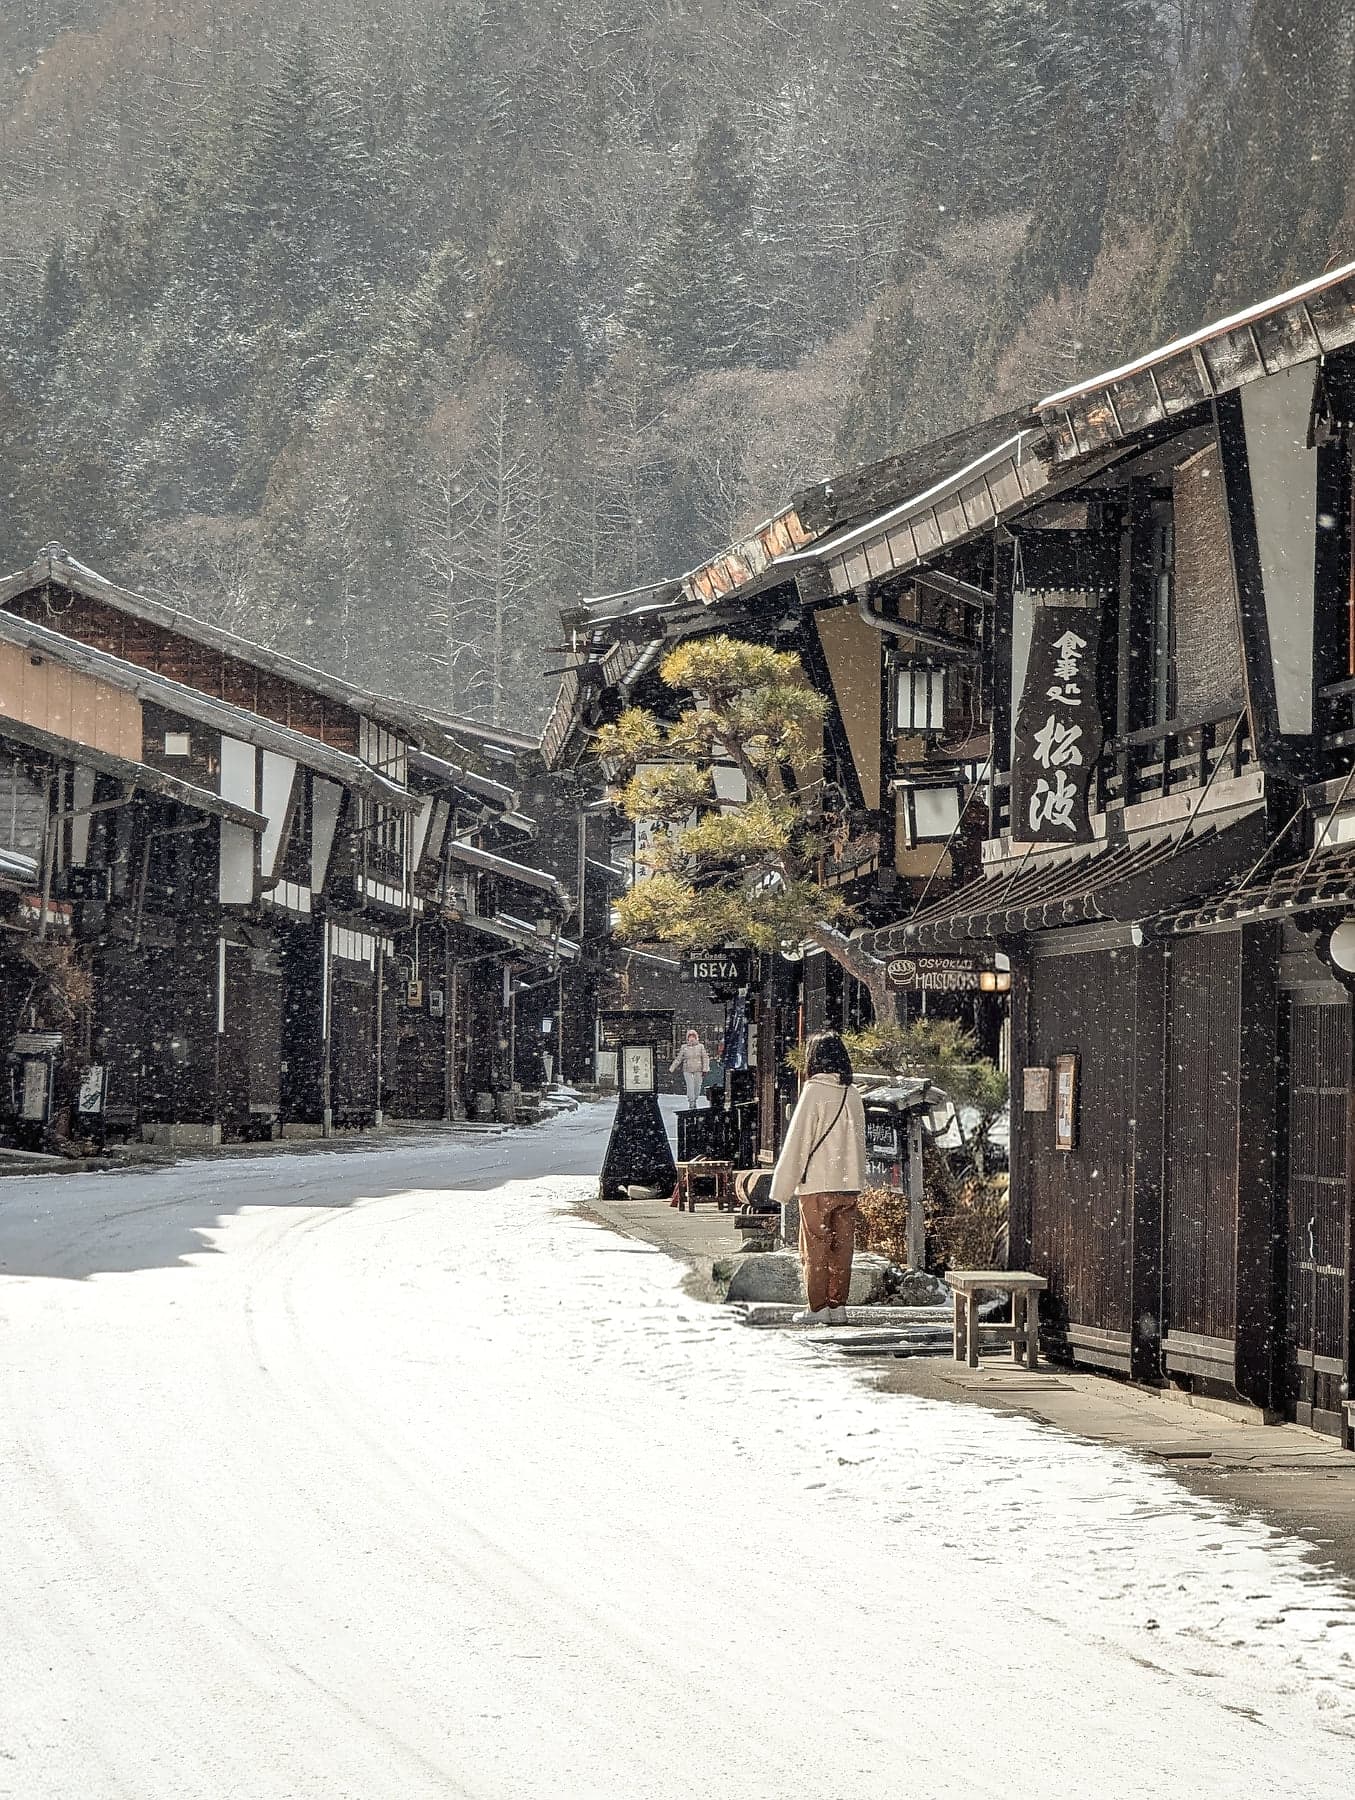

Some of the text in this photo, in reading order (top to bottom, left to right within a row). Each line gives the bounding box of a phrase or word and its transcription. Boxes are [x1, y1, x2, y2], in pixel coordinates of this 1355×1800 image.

[1029, 630, 1087, 832] 食事処 松波
[693, 961, 738, 978] ISEYA
